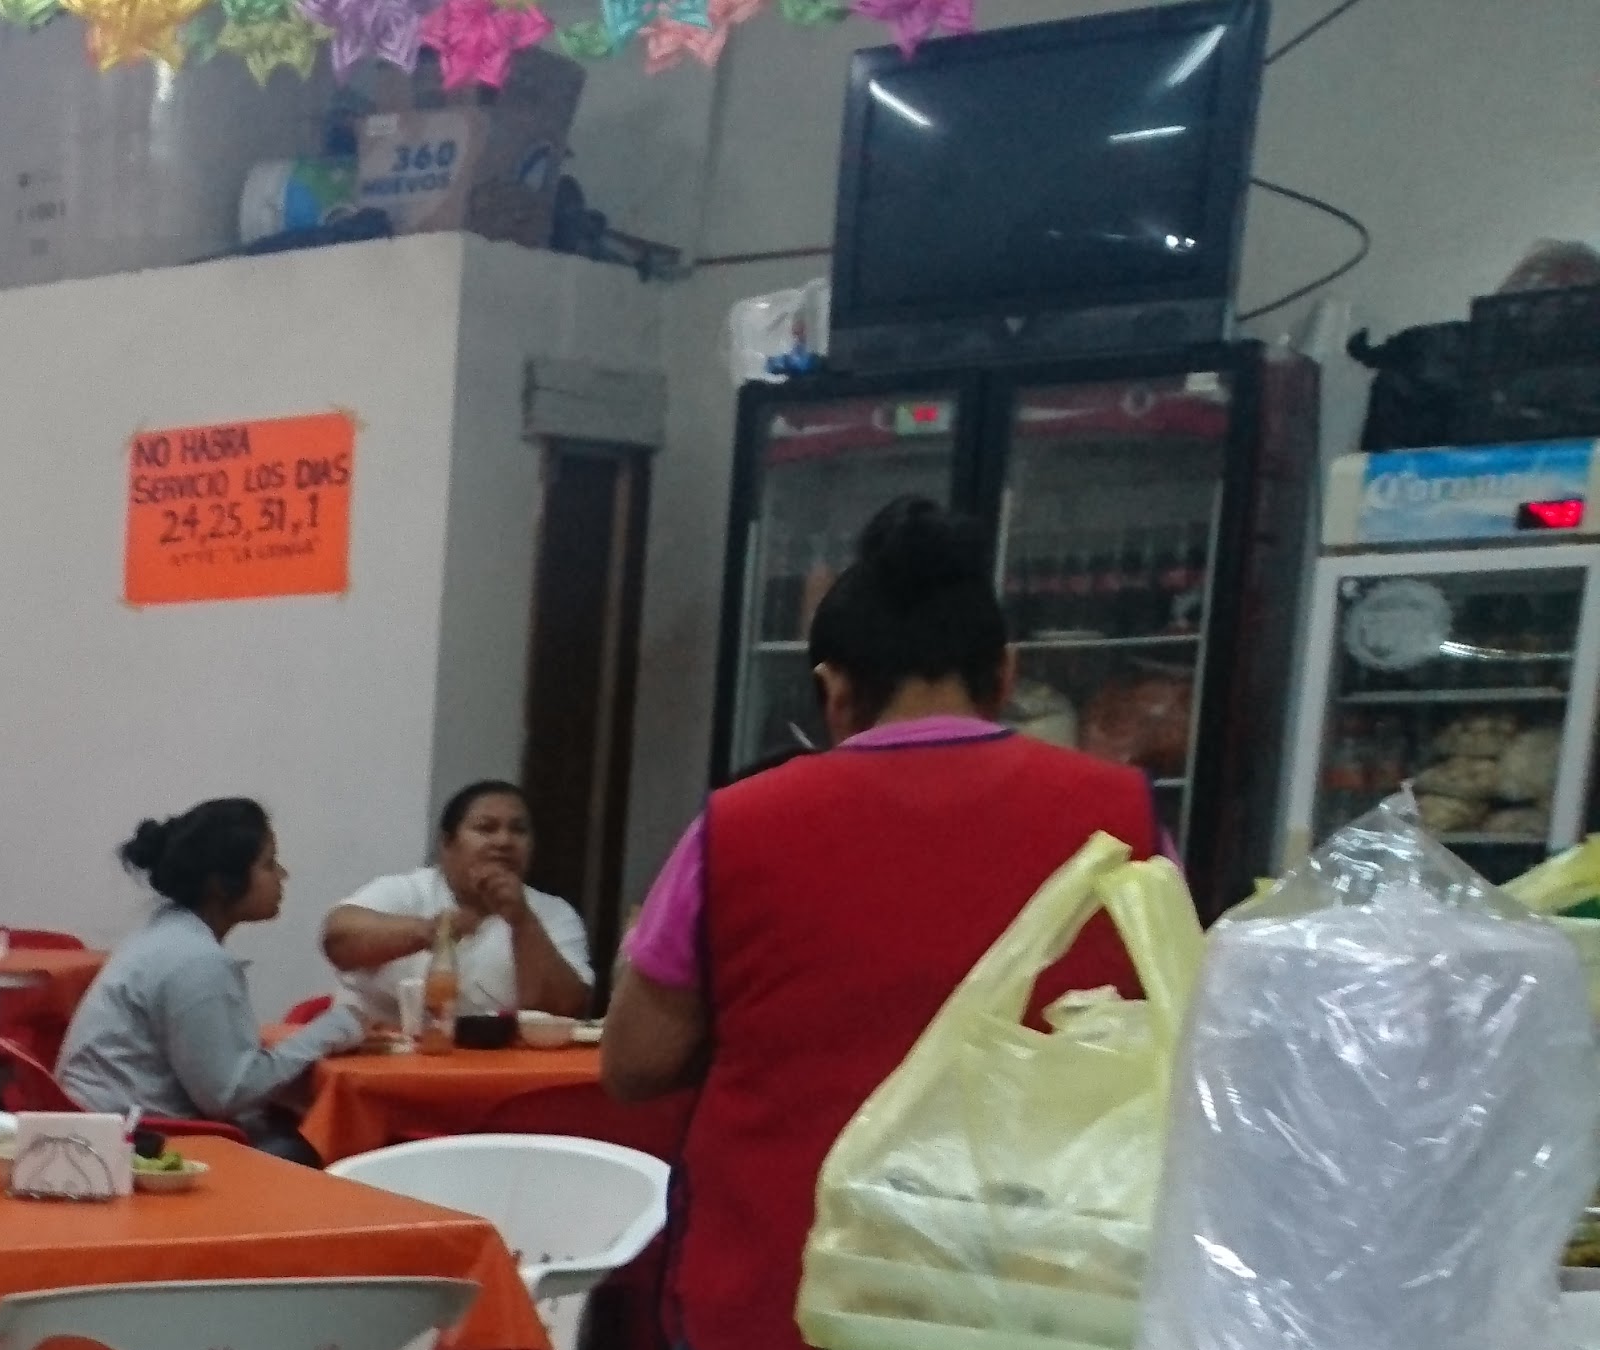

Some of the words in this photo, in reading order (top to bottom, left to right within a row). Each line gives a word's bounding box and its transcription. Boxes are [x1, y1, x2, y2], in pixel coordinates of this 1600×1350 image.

[392, 140, 457, 172] 360
[133, 435, 171, 468] NO
[243, 460, 287, 494] LOS
